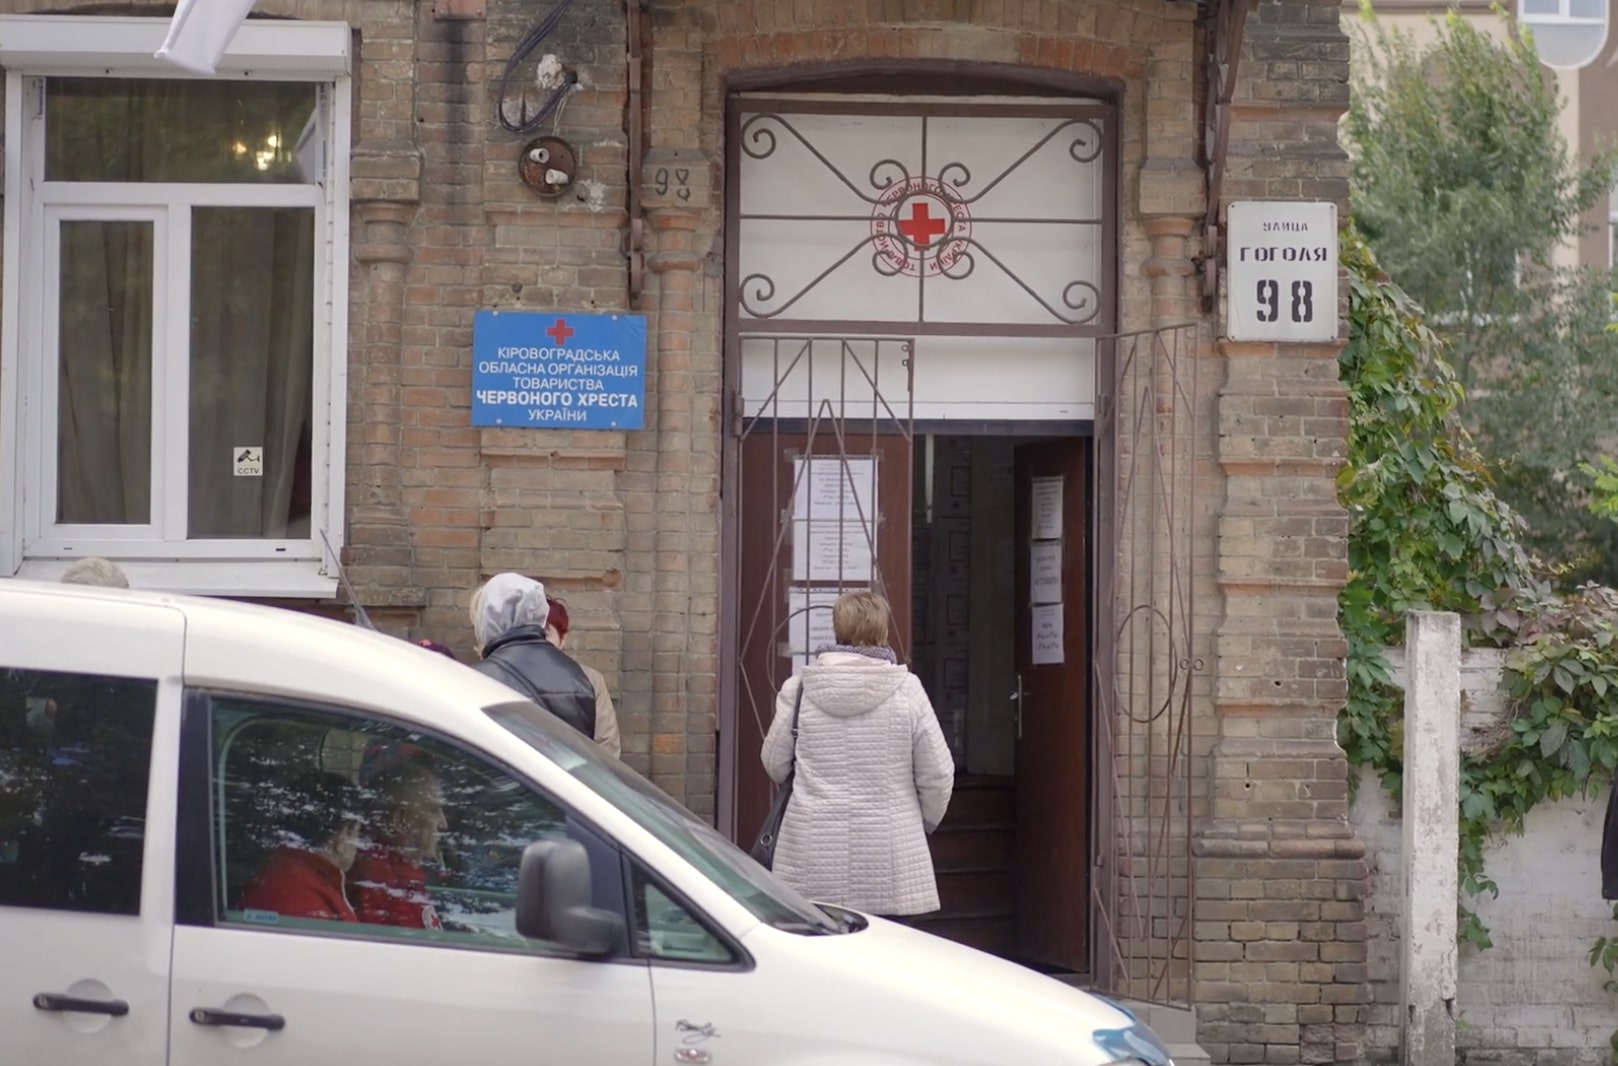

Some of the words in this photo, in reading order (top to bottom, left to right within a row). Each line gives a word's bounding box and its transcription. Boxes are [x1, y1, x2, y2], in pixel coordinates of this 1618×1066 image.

[1262, 222, 1308, 232] УЛИЦА
[876, 212, 916, 272] ТОВАИСТВО
[1240, 247, 1327, 262] ГОГОЛЯ
[1256, 279, 1313, 322] 98
[497, 347, 620, 362] КІРОВОГРАДСЬКА
[478, 361, 546, 374] ОБЛАСНА
[547, 363, 638, 378] ОРГАНІЗАЦІЯ
[512, 377, 604, 391] ТОВАРИСТВА
[476, 390, 572, 406] ЧЕРВОНОГО
[577, 393, 638, 408] ХРЕСТА
[528, 407, 587, 422] УКРАЇНИ
[237, 467, 260, 475] CCTV
